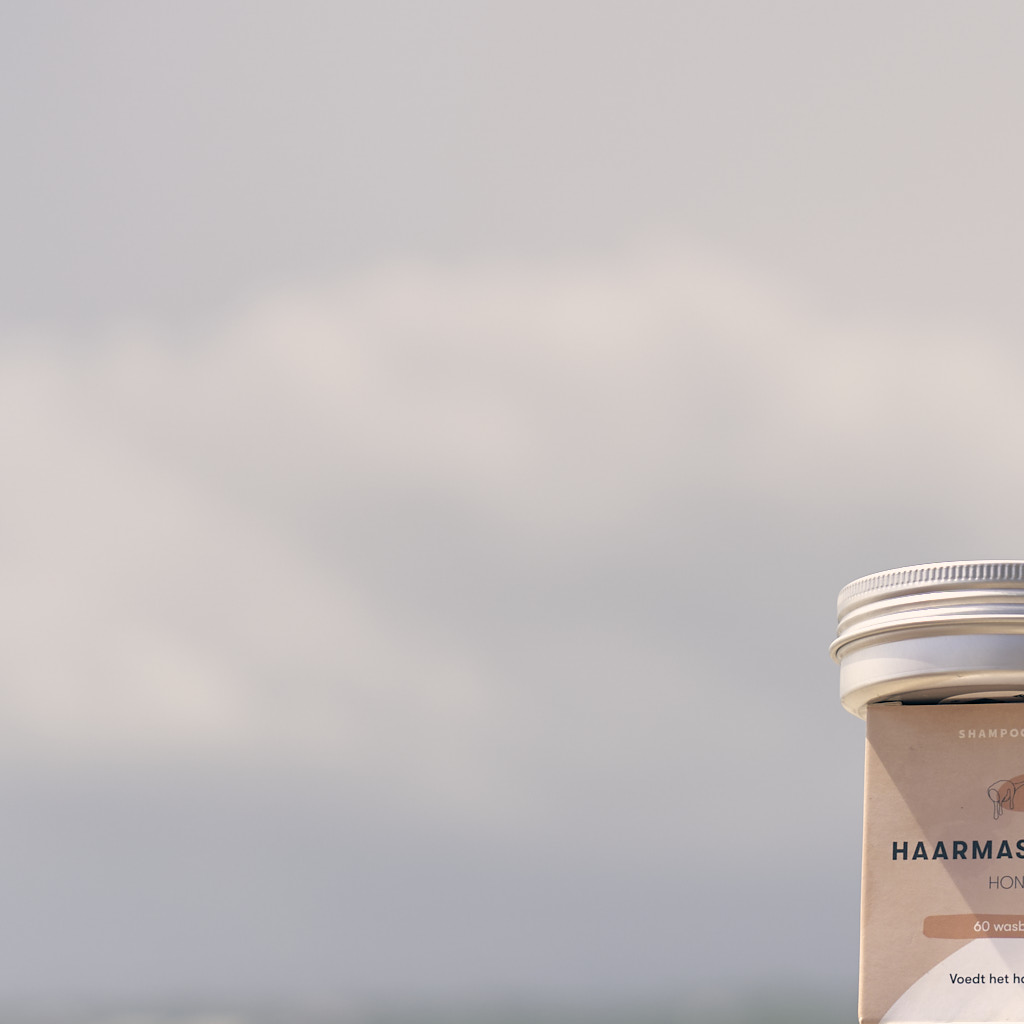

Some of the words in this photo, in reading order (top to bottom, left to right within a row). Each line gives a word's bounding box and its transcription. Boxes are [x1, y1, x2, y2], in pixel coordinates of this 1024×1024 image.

[973, 920, 990, 932] 60
[949, 973, 985, 985] Voedt
[989, 973, 1009, 985] het
